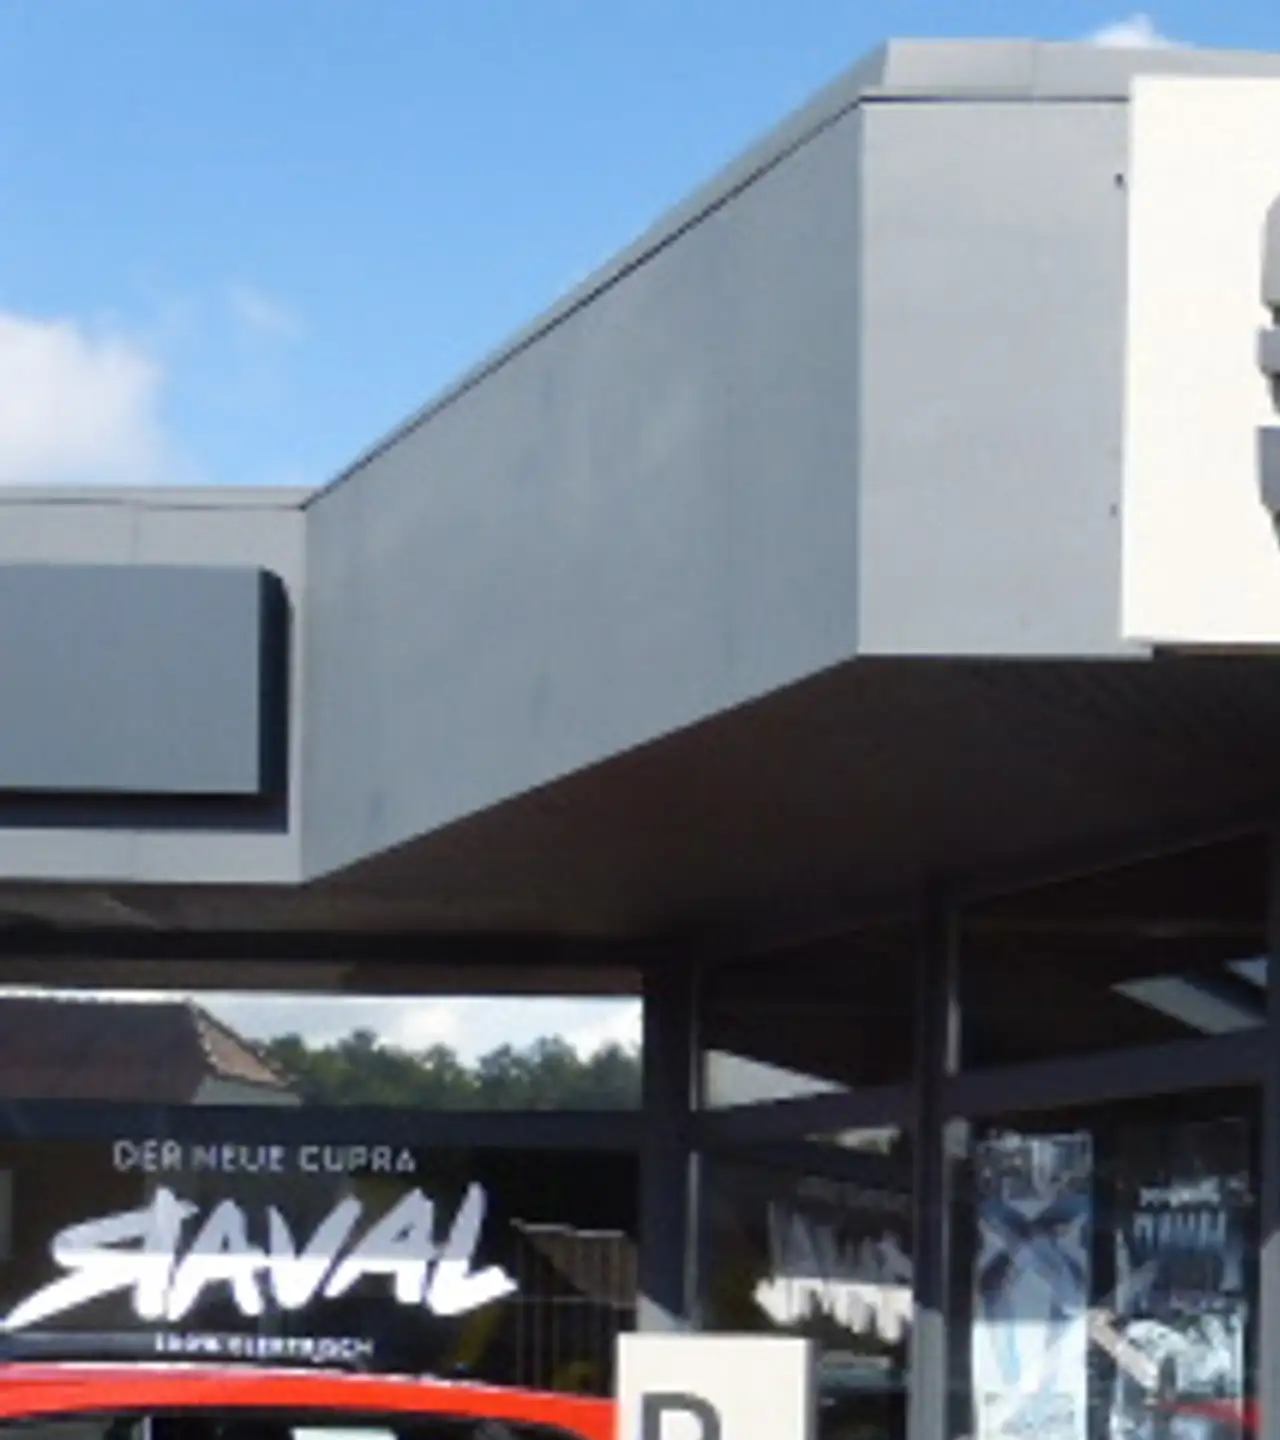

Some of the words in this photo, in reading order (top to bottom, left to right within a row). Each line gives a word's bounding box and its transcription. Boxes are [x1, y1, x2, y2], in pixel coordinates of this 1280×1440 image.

[112, 1139, 183, 1174] DER
[193, 1141, 284, 1174] NEUE
[299, 1144, 418, 1174] CUPRA
[2, 1180, 519, 1330] RAVAL
